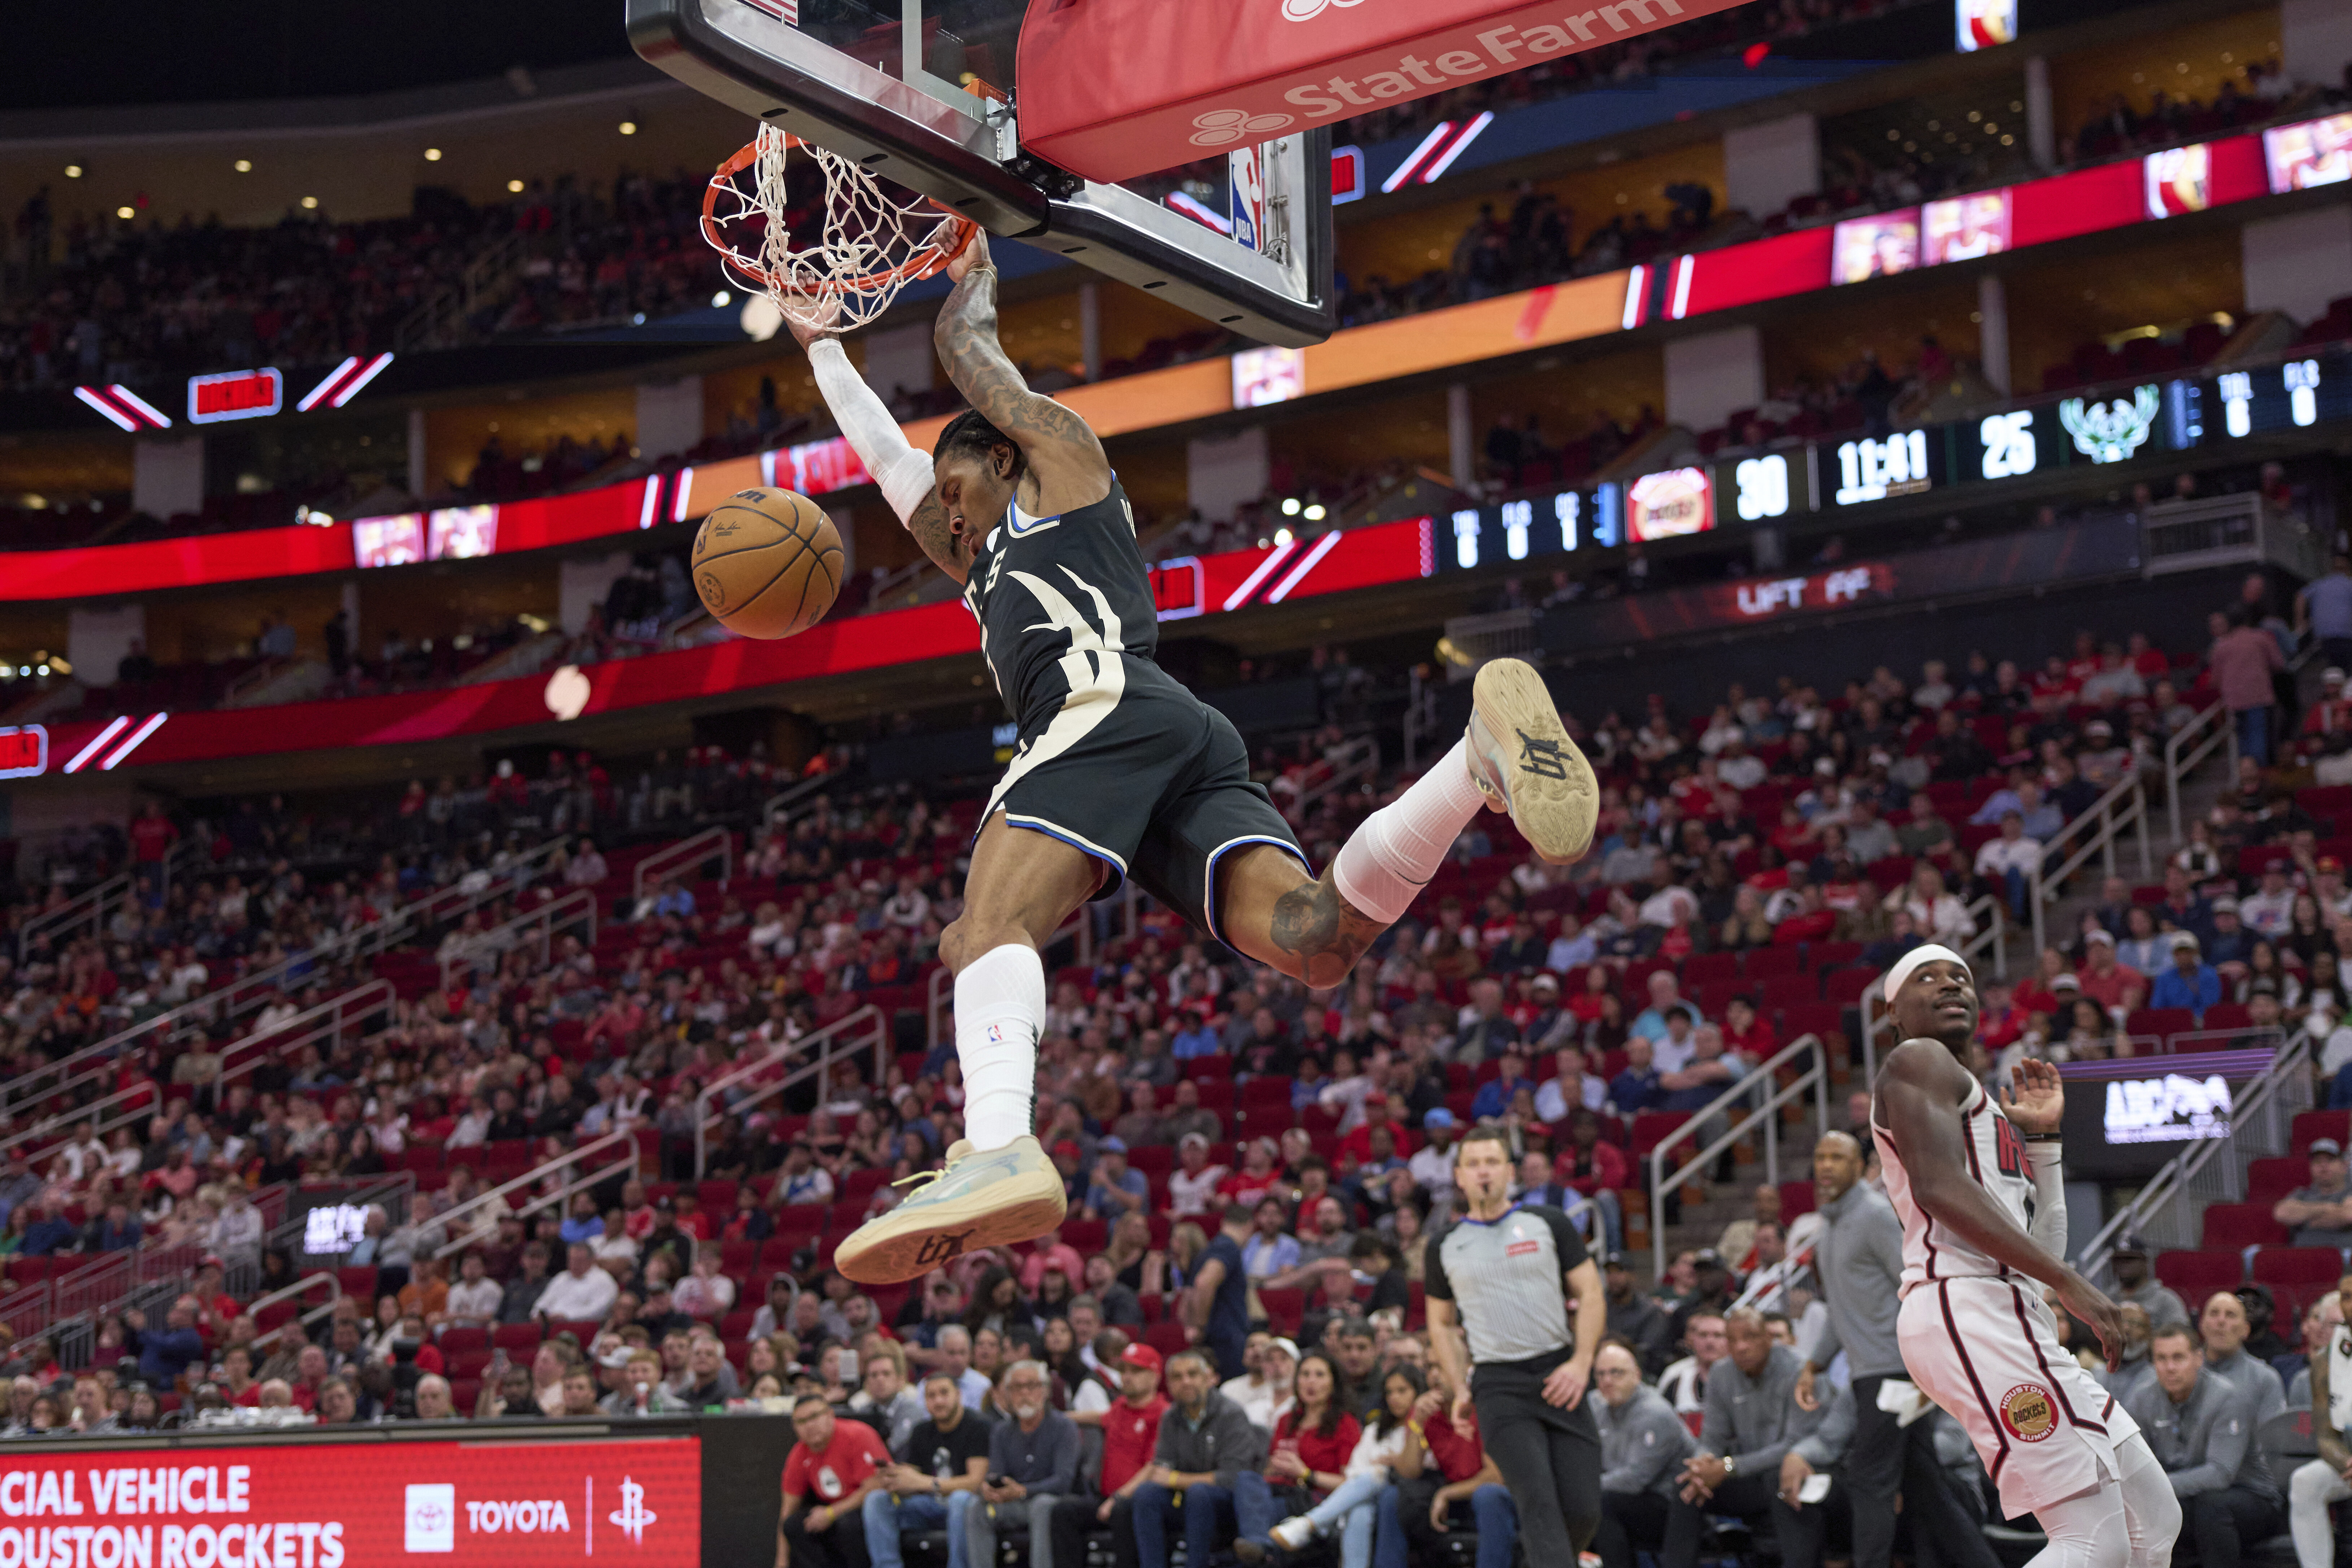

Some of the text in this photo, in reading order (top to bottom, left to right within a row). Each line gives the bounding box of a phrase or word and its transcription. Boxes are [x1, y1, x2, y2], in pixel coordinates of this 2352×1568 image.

[1236, 217, 1251, 243] NBA
[1838, 429, 1927, 488] 11:41
[1980, 409, 2036, 479] 25
[1736, 454, 1789, 520] 30
[2001, 1385, 2045, 1410] HOUSTON
[2019, 1422, 2055, 1441] SUMMIT
[0, 1465, 250, 1516] CIAL VEHICLE
[465, 1500, 570, 1533] TOYOTA
[0, 1521, 345, 1568] OUSTON ROCKETS
